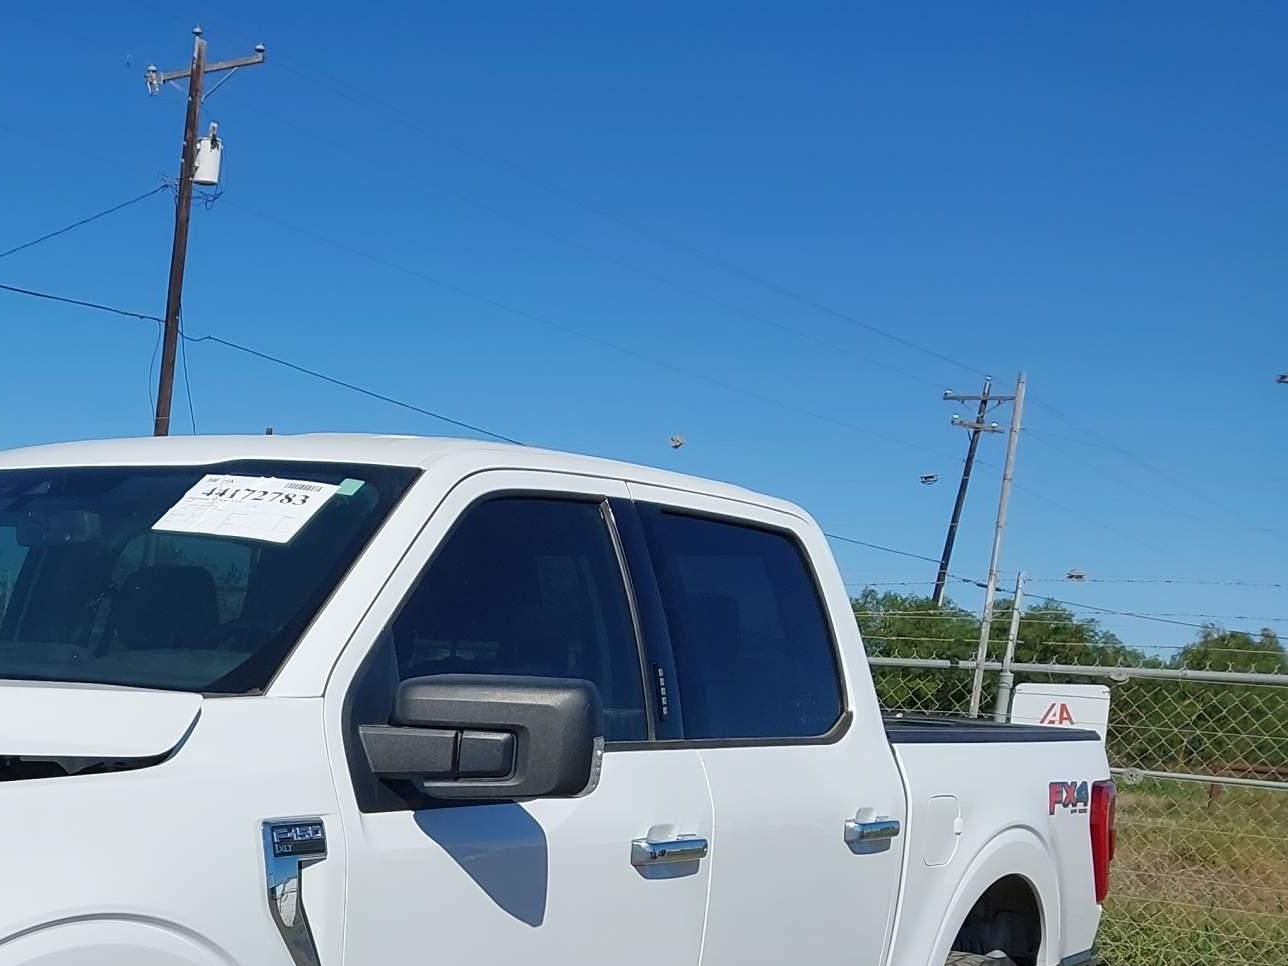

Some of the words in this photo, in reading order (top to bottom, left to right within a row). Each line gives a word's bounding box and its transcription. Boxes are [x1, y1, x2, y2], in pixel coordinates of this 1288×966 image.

[202, 487, 310, 506] 44172783
[1048, 780, 1089, 815] FX4
[273, 825, 323, 840] F-150
